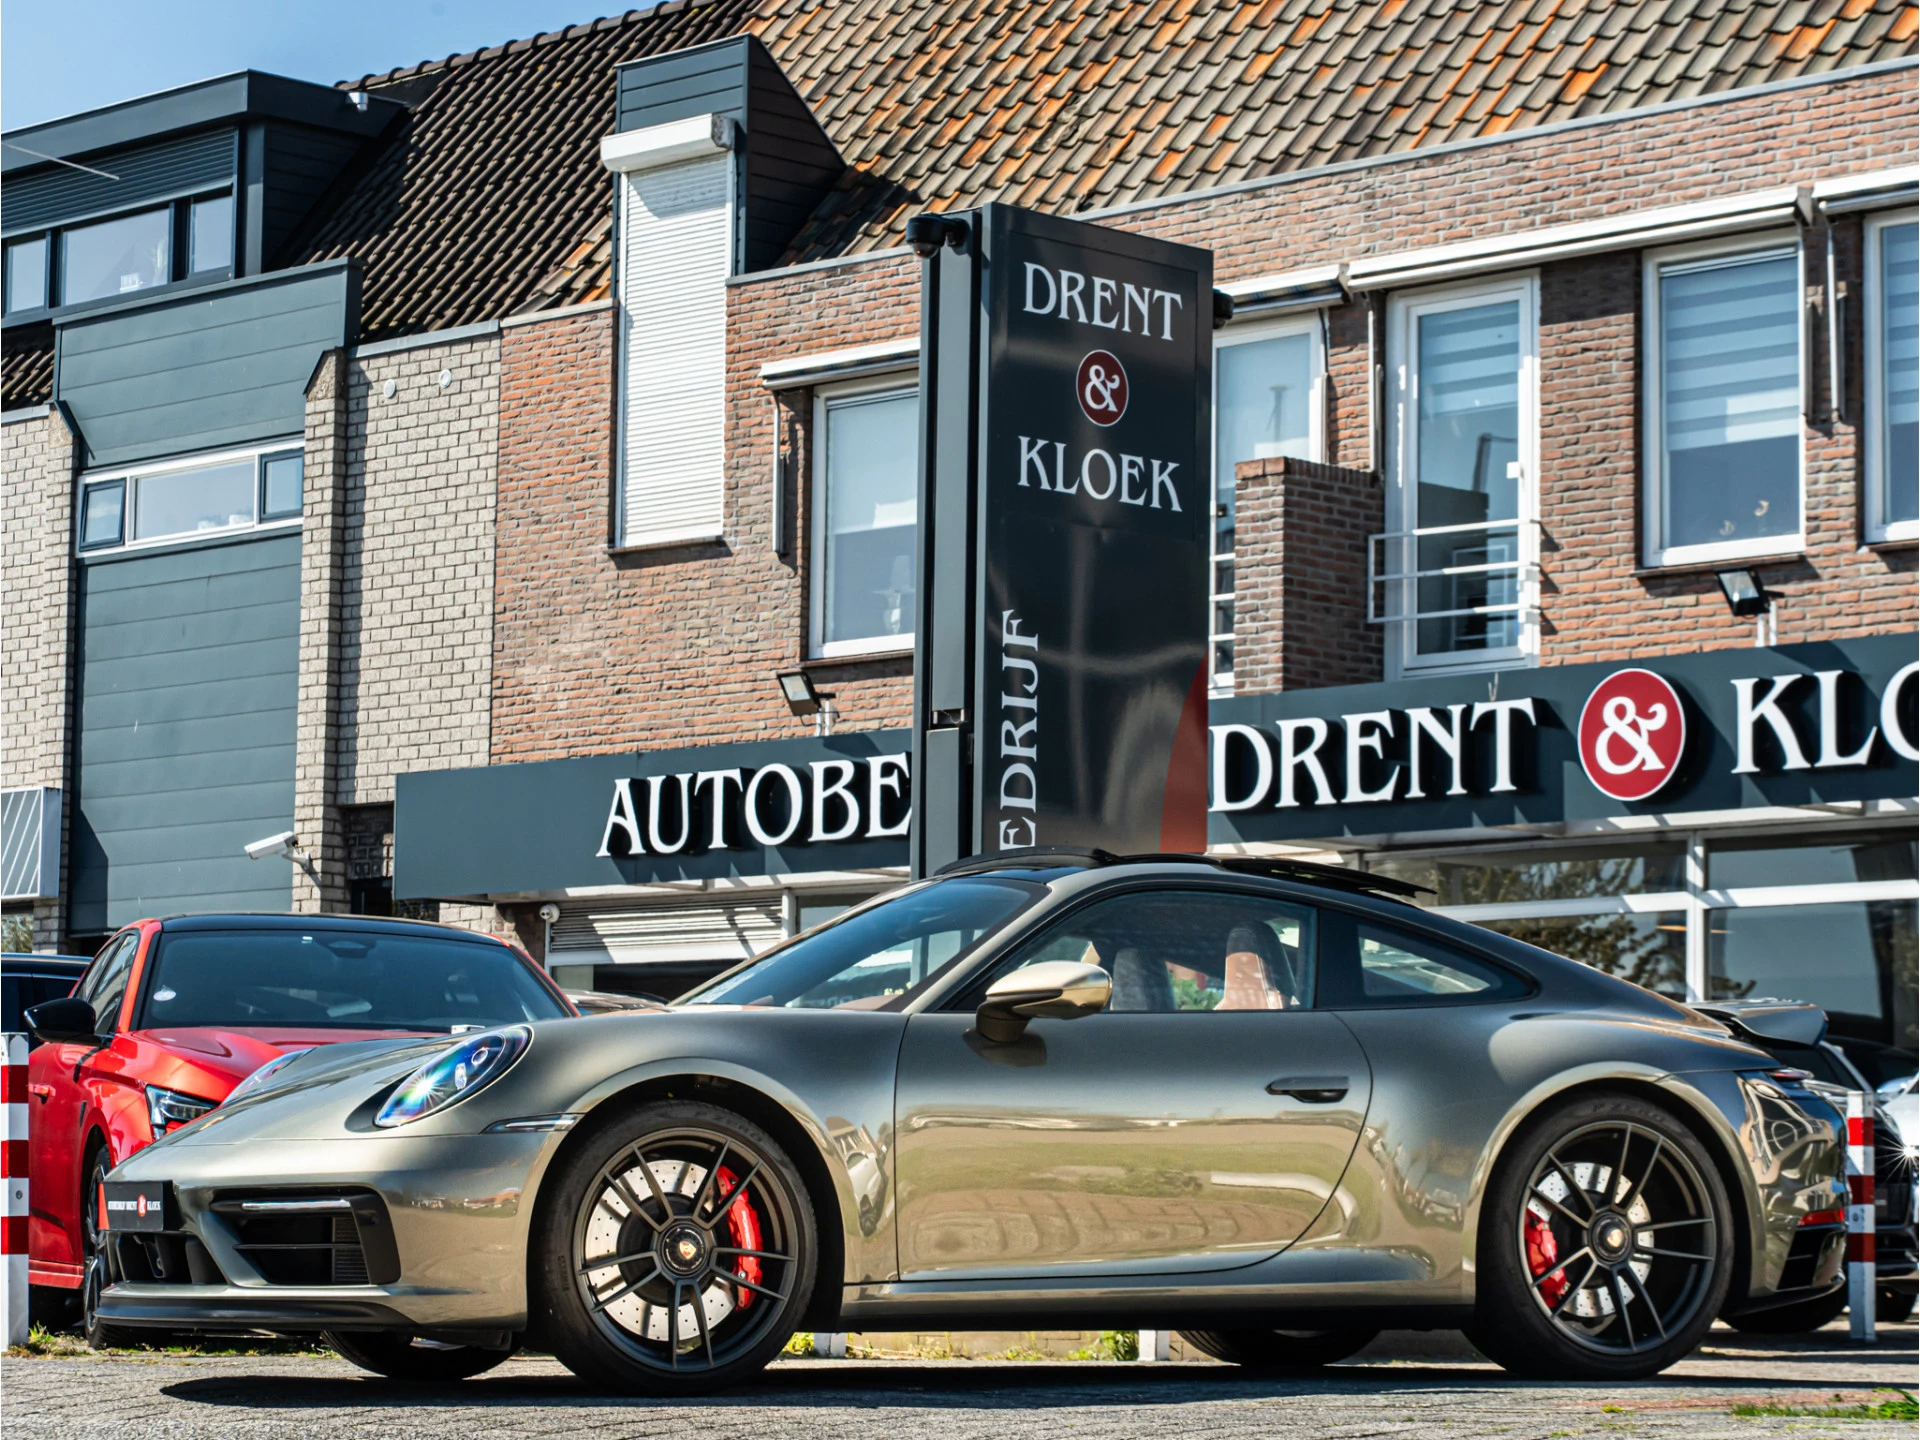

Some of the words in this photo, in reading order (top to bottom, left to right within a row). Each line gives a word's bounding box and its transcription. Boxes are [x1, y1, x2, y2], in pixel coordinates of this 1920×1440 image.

[1023, 262, 1182, 341] DRENT
[1085, 364, 1120, 413] &
[1018, 436, 1182, 512] KLOEK
[1000, 609, 1038, 851] EDRIJF
[595, 752, 913, 858] AUTOBE
[1208, 698, 1536, 813] DRENT
[1595, 696, 1668, 775] &
